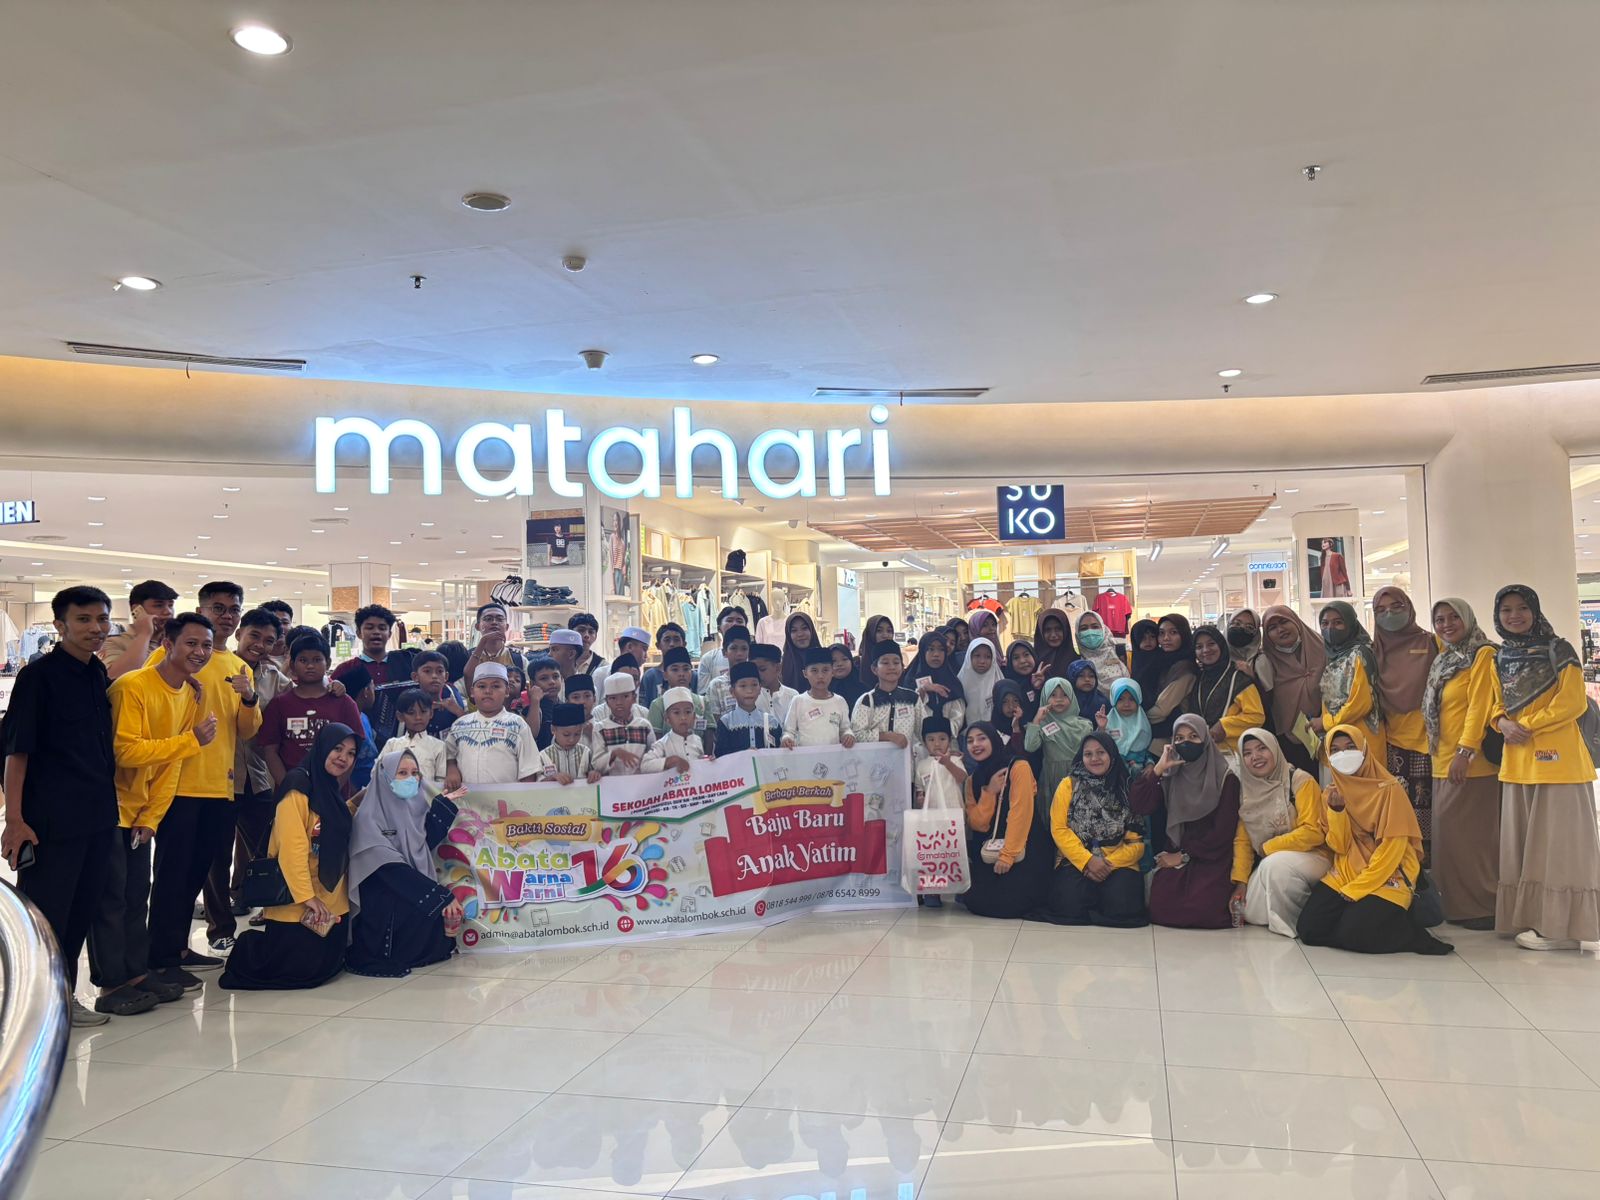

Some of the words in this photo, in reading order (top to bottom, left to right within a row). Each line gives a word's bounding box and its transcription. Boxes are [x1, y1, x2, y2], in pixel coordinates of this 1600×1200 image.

[315, 404, 891, 499] matahari
[0, 500, 33, 523] EN
[1008, 507, 1055, 534] KO
[612, 794, 661, 813] SEKOLAH
[661, 786, 698, 800] ABATA
[700, 777, 745, 793] LOMBOK
[765, 786, 796, 802] Berbagi
[798, 785, 833, 798] Berkah
[506, 824, 543, 837] Bakti
[544, 822, 587, 836] Sosial
[745, 813, 792, 837] Baju
[793, 809, 844, 829] Baru
[475, 847, 572, 870] Abata
[571, 843, 643, 896] 16
[737, 844, 801, 881] Anak
[797, 841, 857, 872] Yatim
[766, 899, 782, 910] 0818
[785, 897, 798, 906] 544
[799, 893, 812, 904] 999
[816, 889, 834, 900] 0878
[835, 888, 857, 898] 6542
[858, 888, 881, 897] 8999
[636, 906, 747, 926] www.abatalombok.sch.id
[480, 921, 610, 940] admin@abatalombok.sch.id
